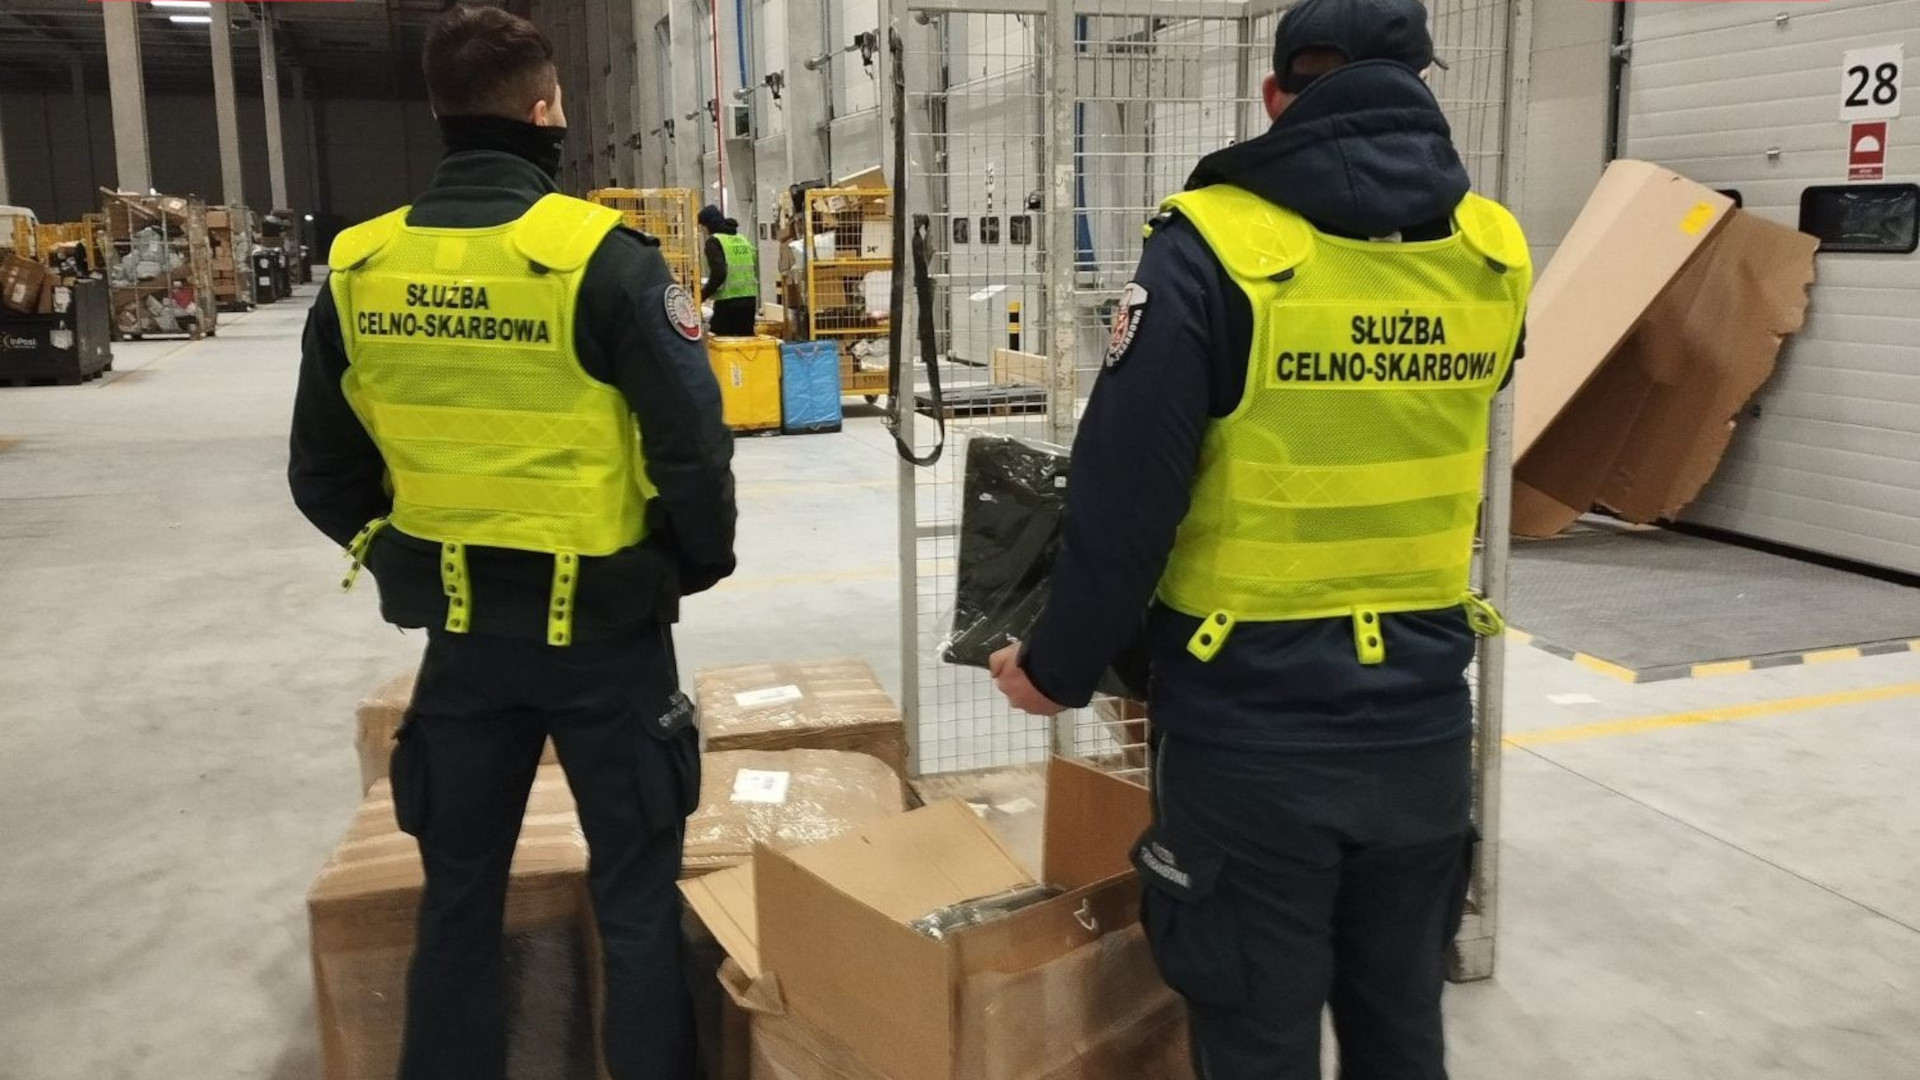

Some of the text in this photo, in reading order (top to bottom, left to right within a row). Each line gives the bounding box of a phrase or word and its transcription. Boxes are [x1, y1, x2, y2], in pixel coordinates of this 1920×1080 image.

[1845, 62, 1898, 107] 28
[406, 281, 489, 309] SŁUŻBA
[358, 311, 550, 343] CELNO-SKARBOWA
[1351, 309, 1445, 344] SŁUŻBA
[1277, 352, 1496, 381] CELNO-SKARBOWA
